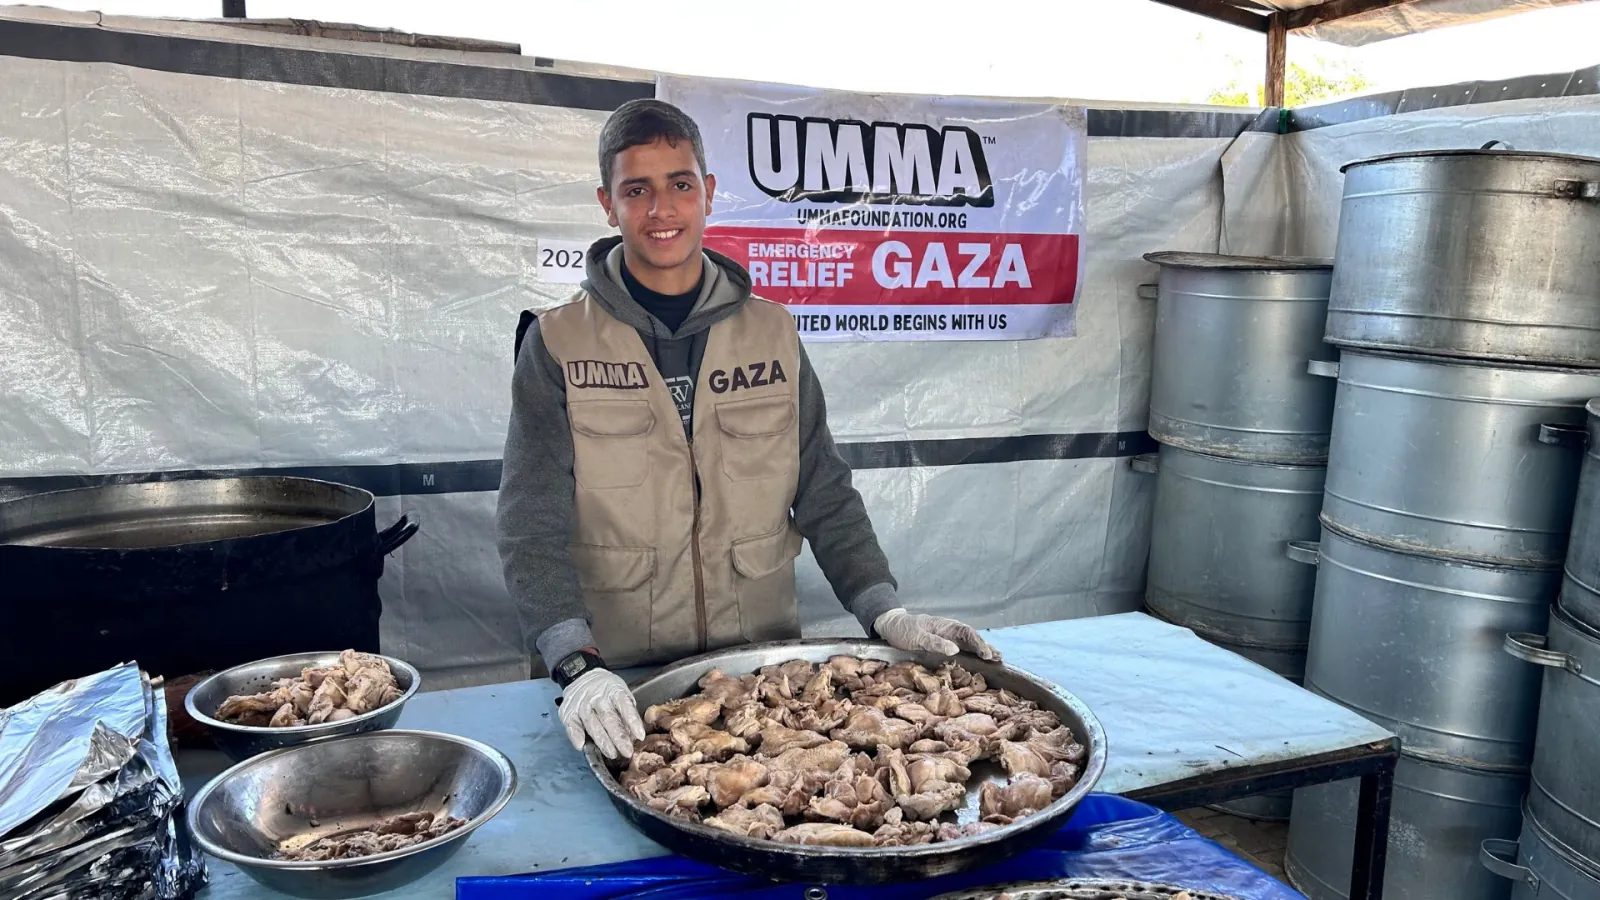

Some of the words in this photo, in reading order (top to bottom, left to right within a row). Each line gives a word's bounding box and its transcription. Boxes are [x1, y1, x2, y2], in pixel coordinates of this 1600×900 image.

[748, 113, 994, 207] UMMA
[797, 208, 967, 229] UMMAFOUNDATION.ORG
[748, 242, 854, 258] EMERGENCY
[748, 260, 854, 287] RELIEF
[871, 240, 1033, 290] GAZA
[793, 314, 831, 332] ITED
[835, 314, 889, 332] WORLD
[893, 313, 948, 332] BEGINS
[951, 313, 985, 331] WITH
[988, 313, 1007, 330] US
[567, 360, 650, 390] UMMA
[708, 359, 788, 394] GAZA
[422, 474, 435, 486] M
